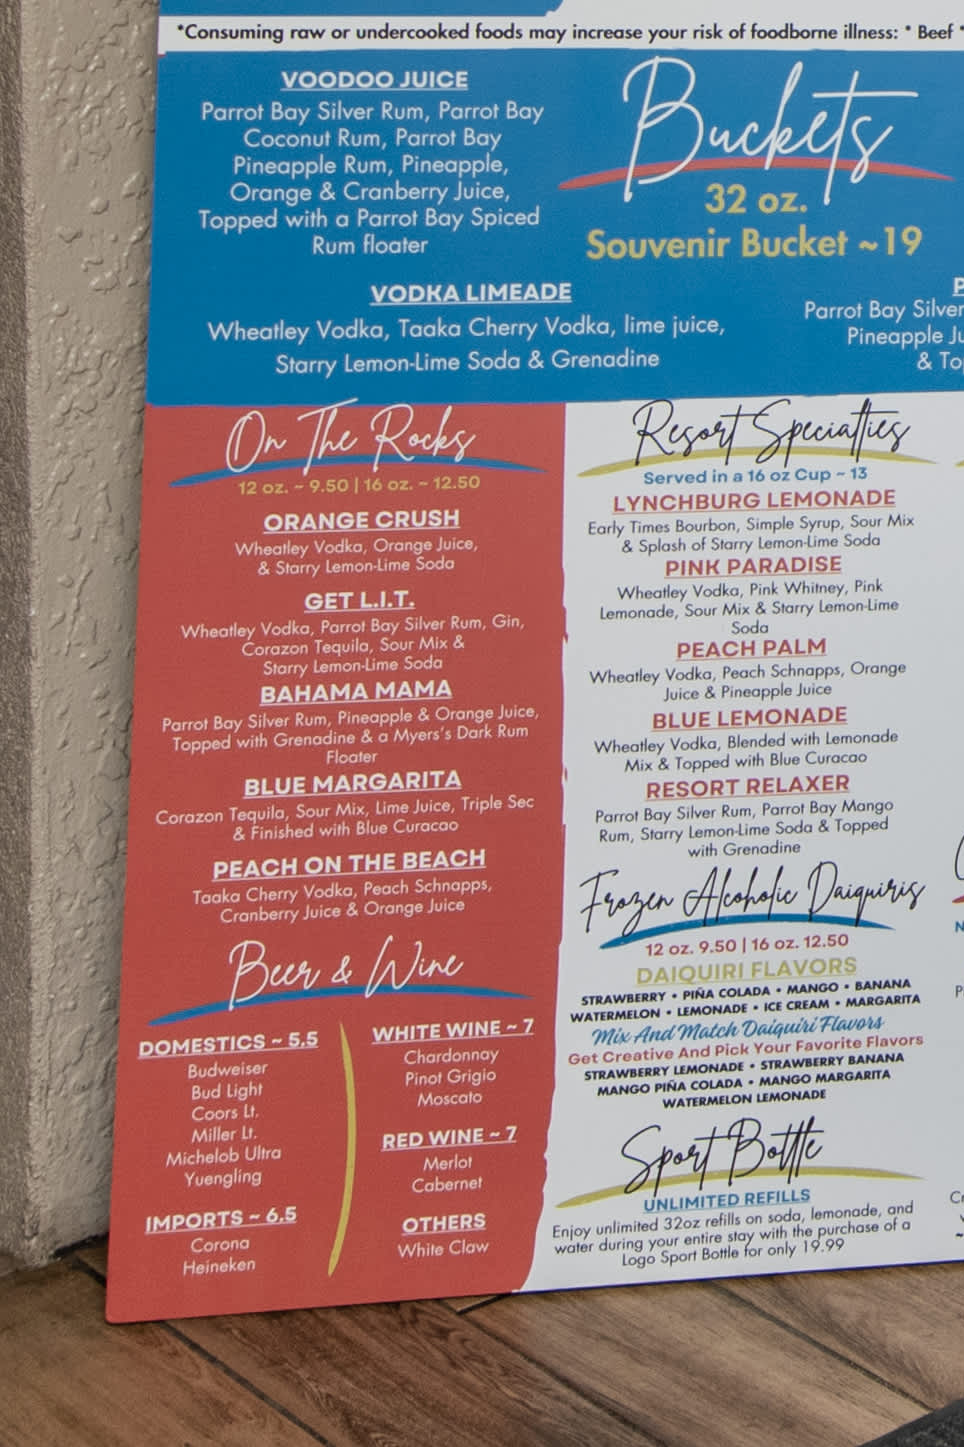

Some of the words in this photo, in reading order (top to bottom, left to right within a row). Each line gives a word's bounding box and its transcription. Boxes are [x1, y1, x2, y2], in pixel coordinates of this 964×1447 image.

[622, 54, 920, 206] Buckets
[705, 183, 747, 215] 32
[757, 192, 808, 215] oz.
[586, 228, 732, 261] Souvenir
[742, 225, 848, 257] Bucket
[371, 284, 459, 304] VODKA
[467, 283, 571, 302] LIMEADE
[226, 410, 287, 473] On
[298, 397, 358, 476] The
[370, 404, 476, 473] Rocks
[633, 399, 769, 465] Resort
[752, 397, 911, 467] Specialties
[665, 559, 720, 576] PINK
[727, 556, 842, 575] PARADISE
[229, 940, 320, 1012] Beer
[331, 955, 352, 985] &
[365, 935, 464, 998] Wine
[372, 1023, 440, 1042] WHITE
[446, 1020, 500, 1038] WINE
[523, 1019, 534, 1034] 7
[188, 1060, 268, 1078] Budweiser
[192, 1084, 221, 1100] Bud
[227, 1082, 263, 1102] Light
[621, 1124, 743, 1197] Sport
[728, 1116, 825, 1187] Bottle
[191, 1236, 249, 1253] Corona
[622, 1252, 656, 1268] Logo
[660, 1249, 697, 1266] Sport
[702, 1247, 739, 1261] Bottle
[743, 1246, 762, 1259] for
[768, 1242, 798, 1259] only
[804, 1238, 844, 1255] 19.99
[183, 1258, 256, 1275] Heineken
